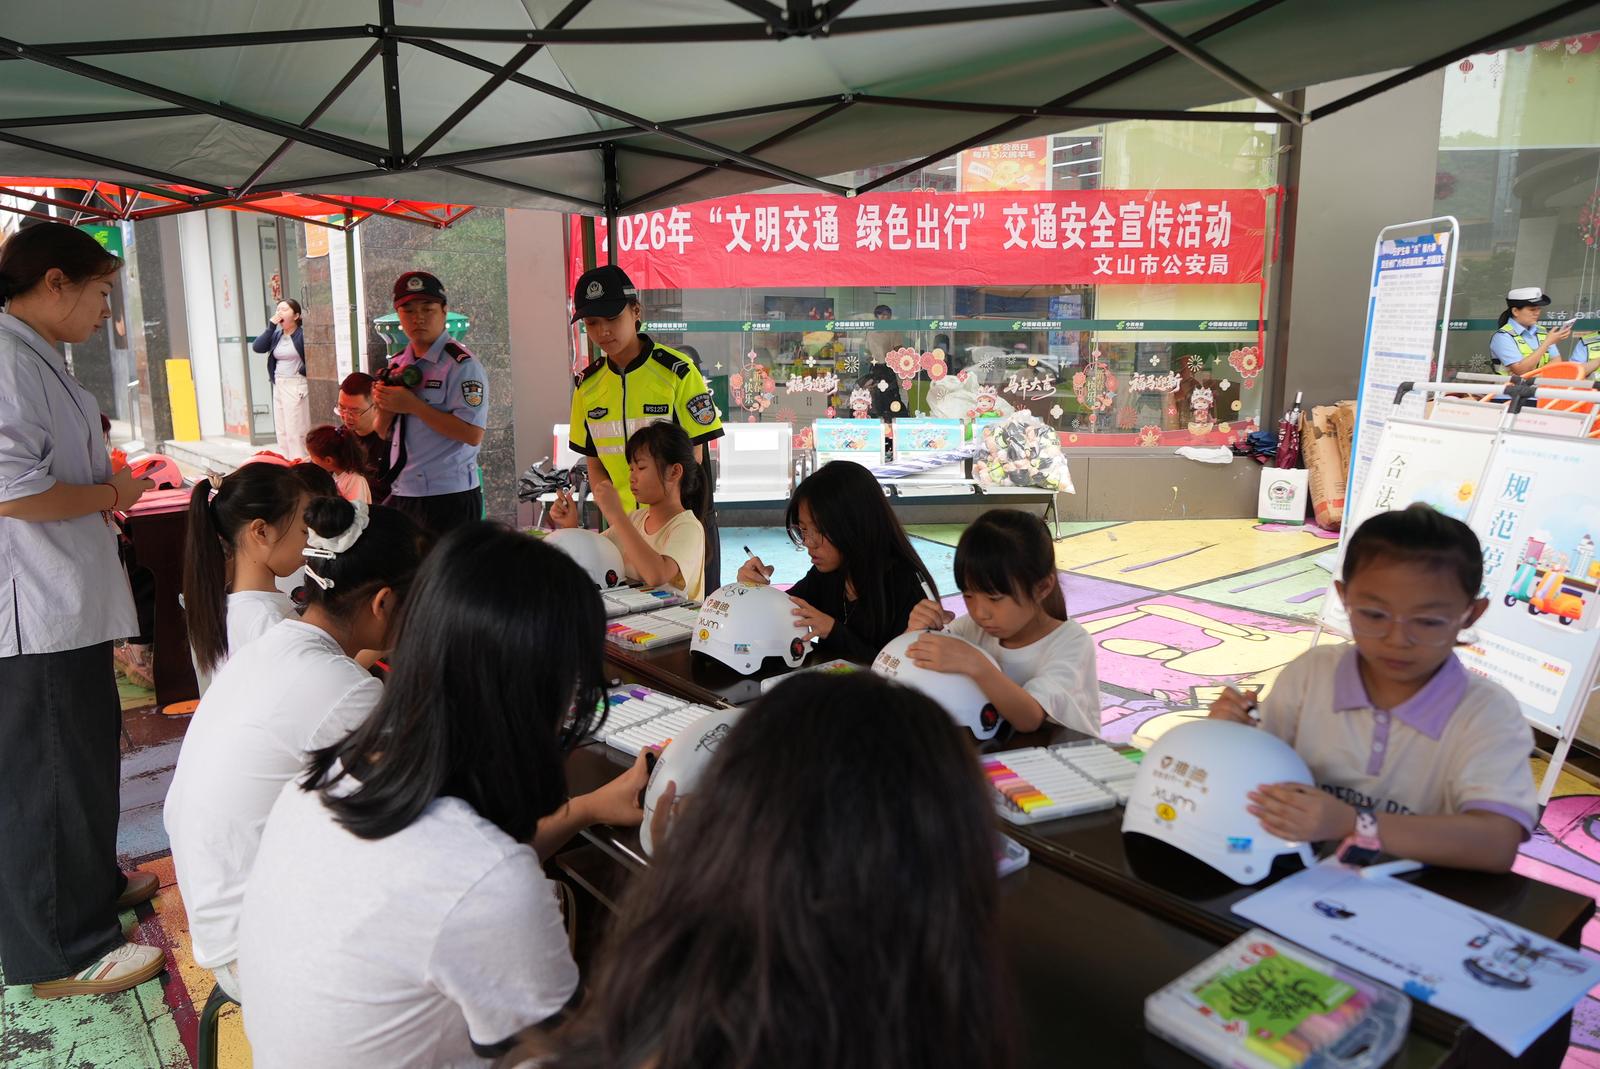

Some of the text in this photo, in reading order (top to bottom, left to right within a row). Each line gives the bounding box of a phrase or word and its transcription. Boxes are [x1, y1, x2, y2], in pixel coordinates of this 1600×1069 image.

[709, 205, 840, 253] “文明交通
[855, 202, 985, 252] 绿色出行”
[1002, 200, 1231, 250] 交通安全宣传活动
[1093, 254, 1229, 275] 文山市公安局
[1003, 374, 1057, 401] 马年大吉
